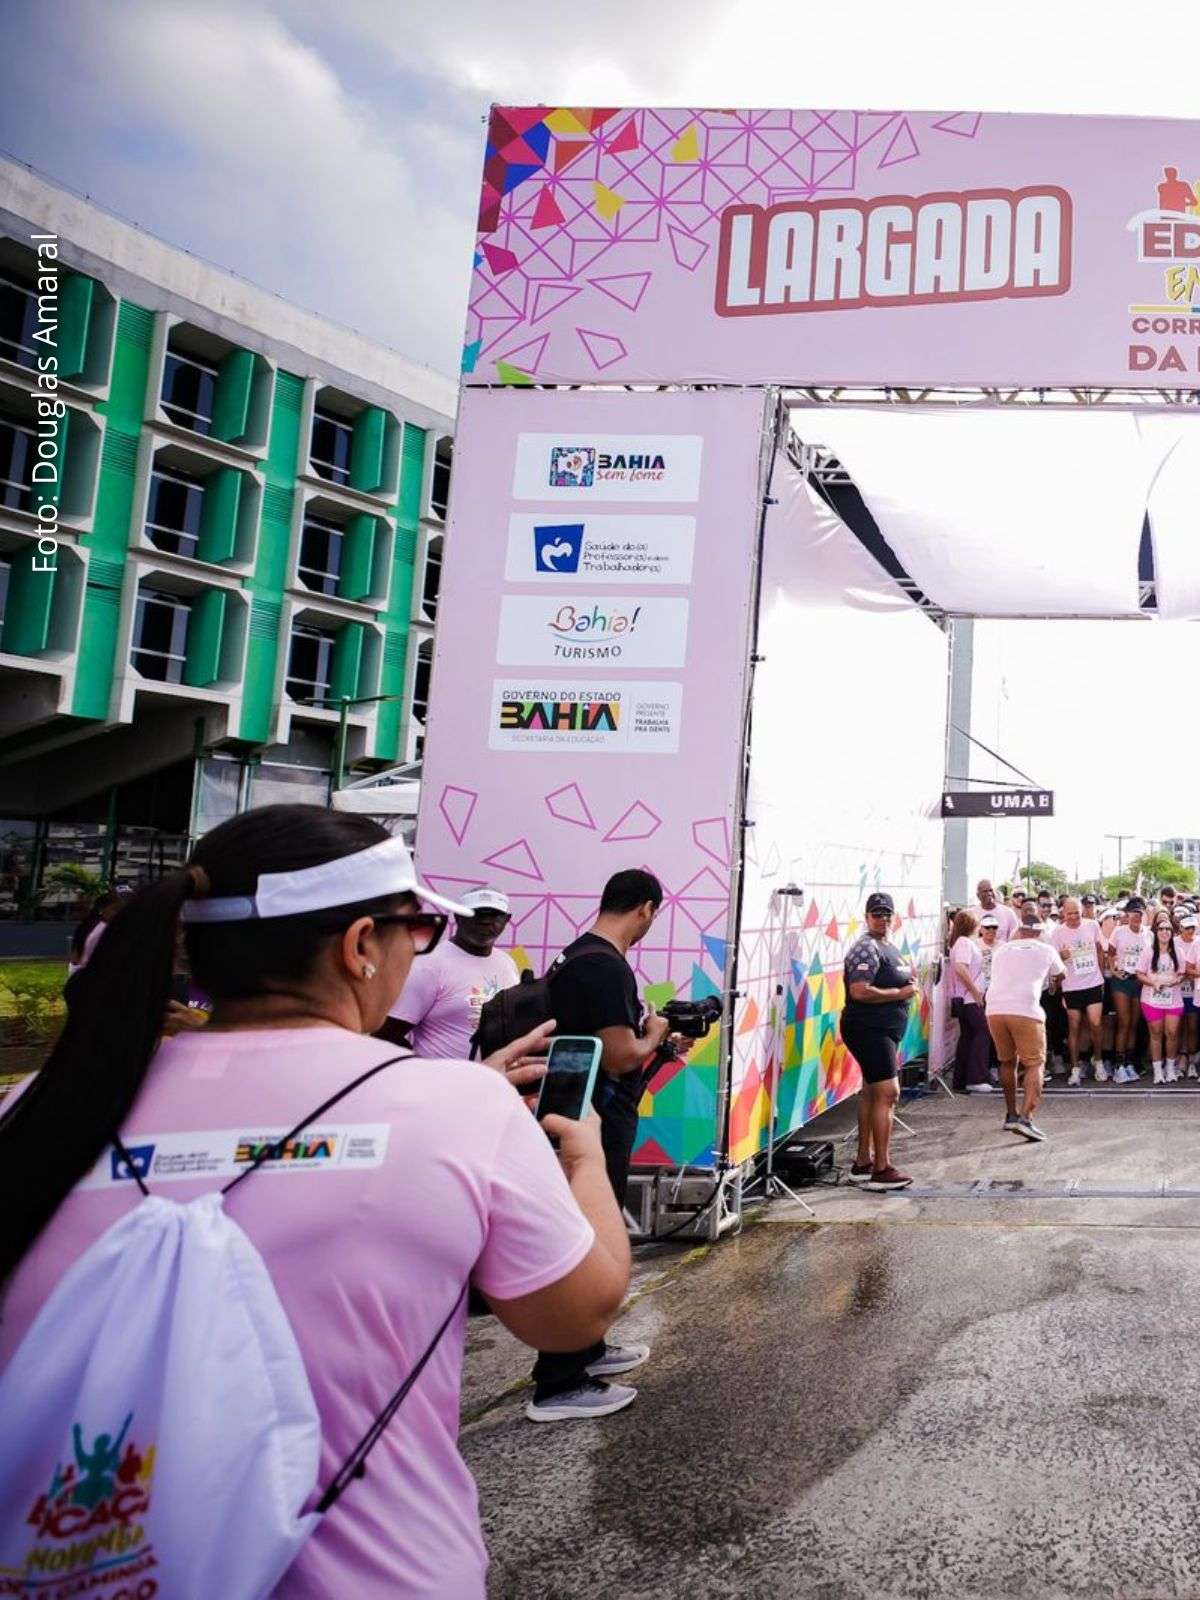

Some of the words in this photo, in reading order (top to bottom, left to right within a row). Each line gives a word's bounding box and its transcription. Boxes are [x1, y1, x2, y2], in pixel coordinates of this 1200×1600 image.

[726, 196, 1062, 307] LARGADA
[1128, 345, 1187, 373] DA
[598, 455, 665, 469] BAHIA
[547, 605, 641, 633] Bahia!
[553, 645, 622, 659] TURISMO
[502, 690, 557, 701] GOVERNO
[560, 691, 576, 701] DO
[579, 691, 621, 702] ESTADO
[500, 701, 619, 731] BAHIA
